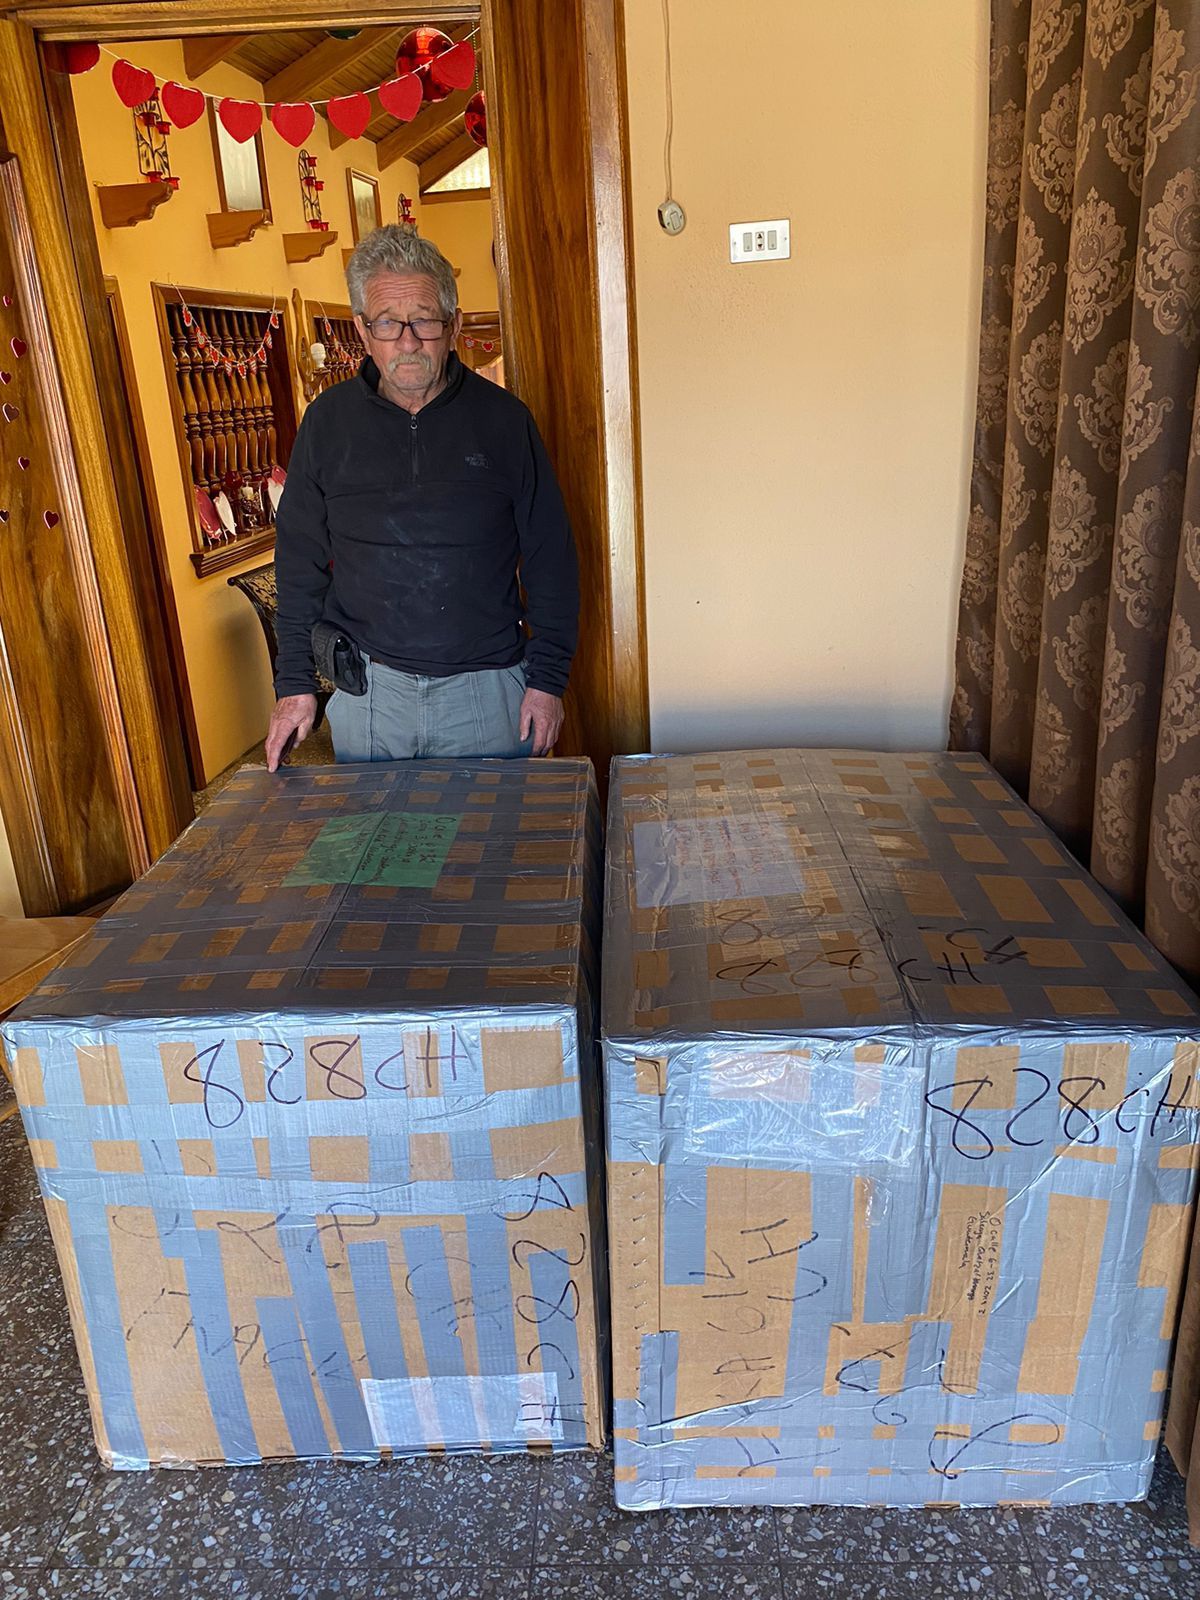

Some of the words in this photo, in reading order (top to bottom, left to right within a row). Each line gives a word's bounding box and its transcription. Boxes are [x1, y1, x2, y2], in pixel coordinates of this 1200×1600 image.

[183, 1024, 470, 1129] 828CH
[924, 1067, 1196, 1161] 828CH
[491, 1171, 590, 1427] 828CH
